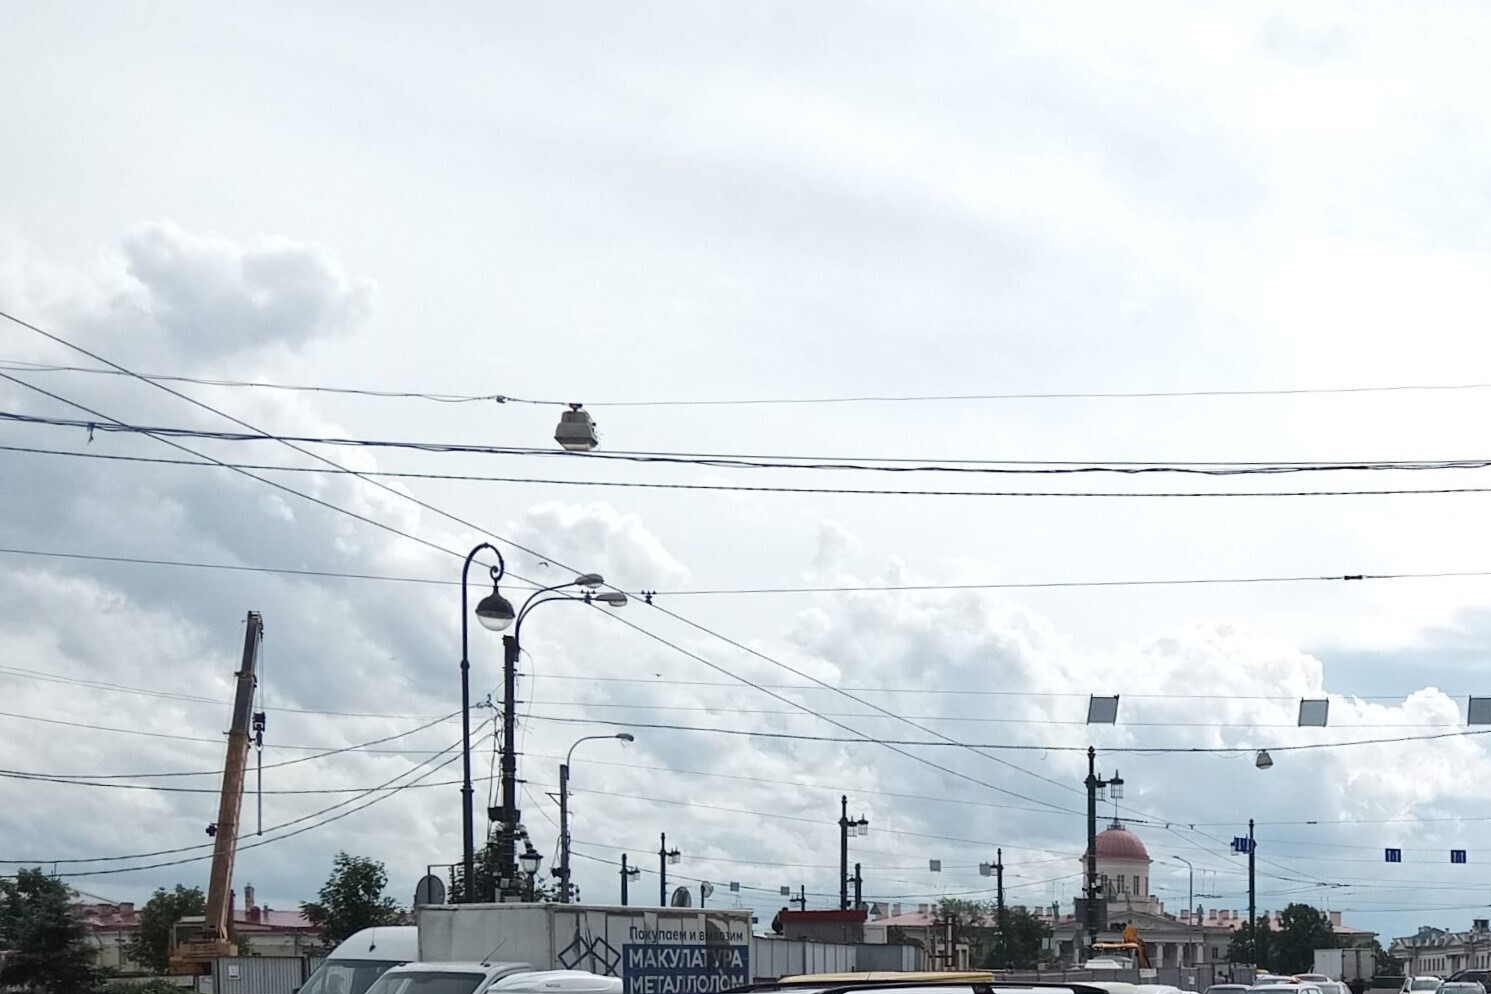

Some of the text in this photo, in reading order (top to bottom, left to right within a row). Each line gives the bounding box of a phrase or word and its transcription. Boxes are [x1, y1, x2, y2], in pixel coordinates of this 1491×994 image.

[629, 927, 743, 943] Покупаем и вывозим
[629, 949, 743, 968] МАКУЛАТУРА
[630, 975, 744, 994] МЕТАЛЛОЛОМ
